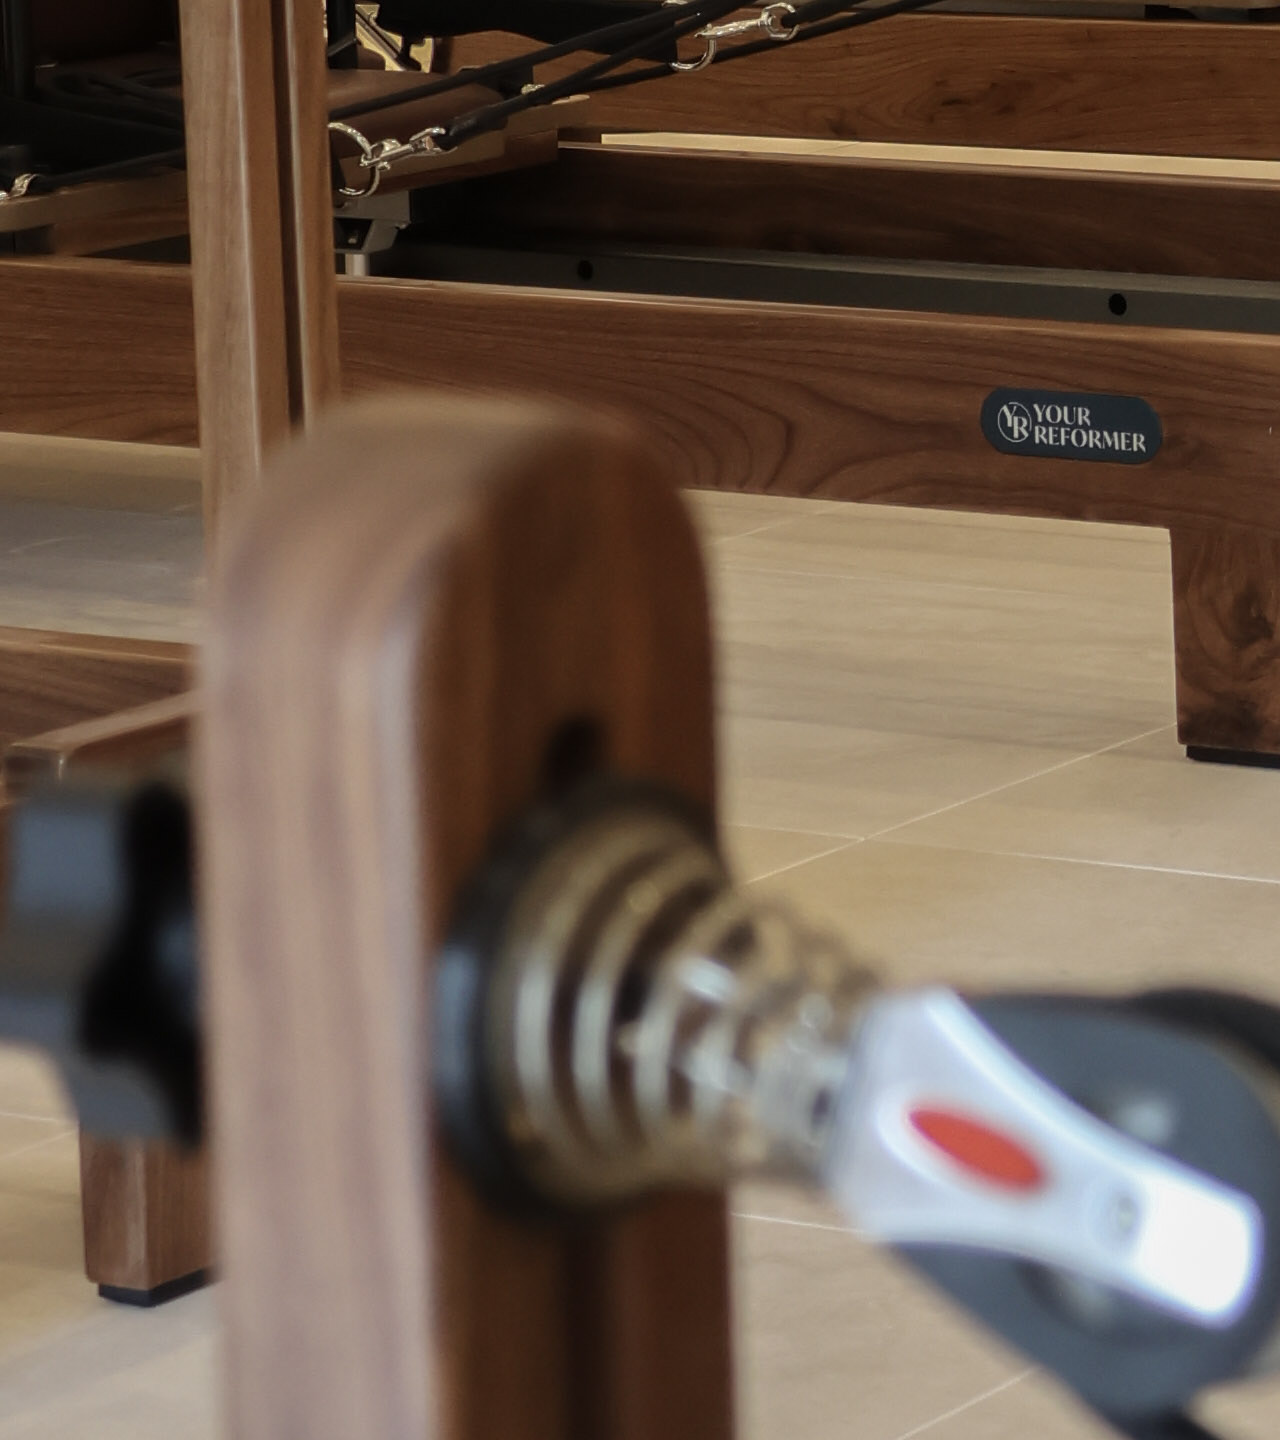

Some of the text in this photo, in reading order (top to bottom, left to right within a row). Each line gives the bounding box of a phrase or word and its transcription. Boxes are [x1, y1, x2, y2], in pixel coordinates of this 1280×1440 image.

[1001, 404, 1030, 440] YR
[1033, 403, 1091, 426] YOUR
[1034, 425, 1147, 453] REFORMER
